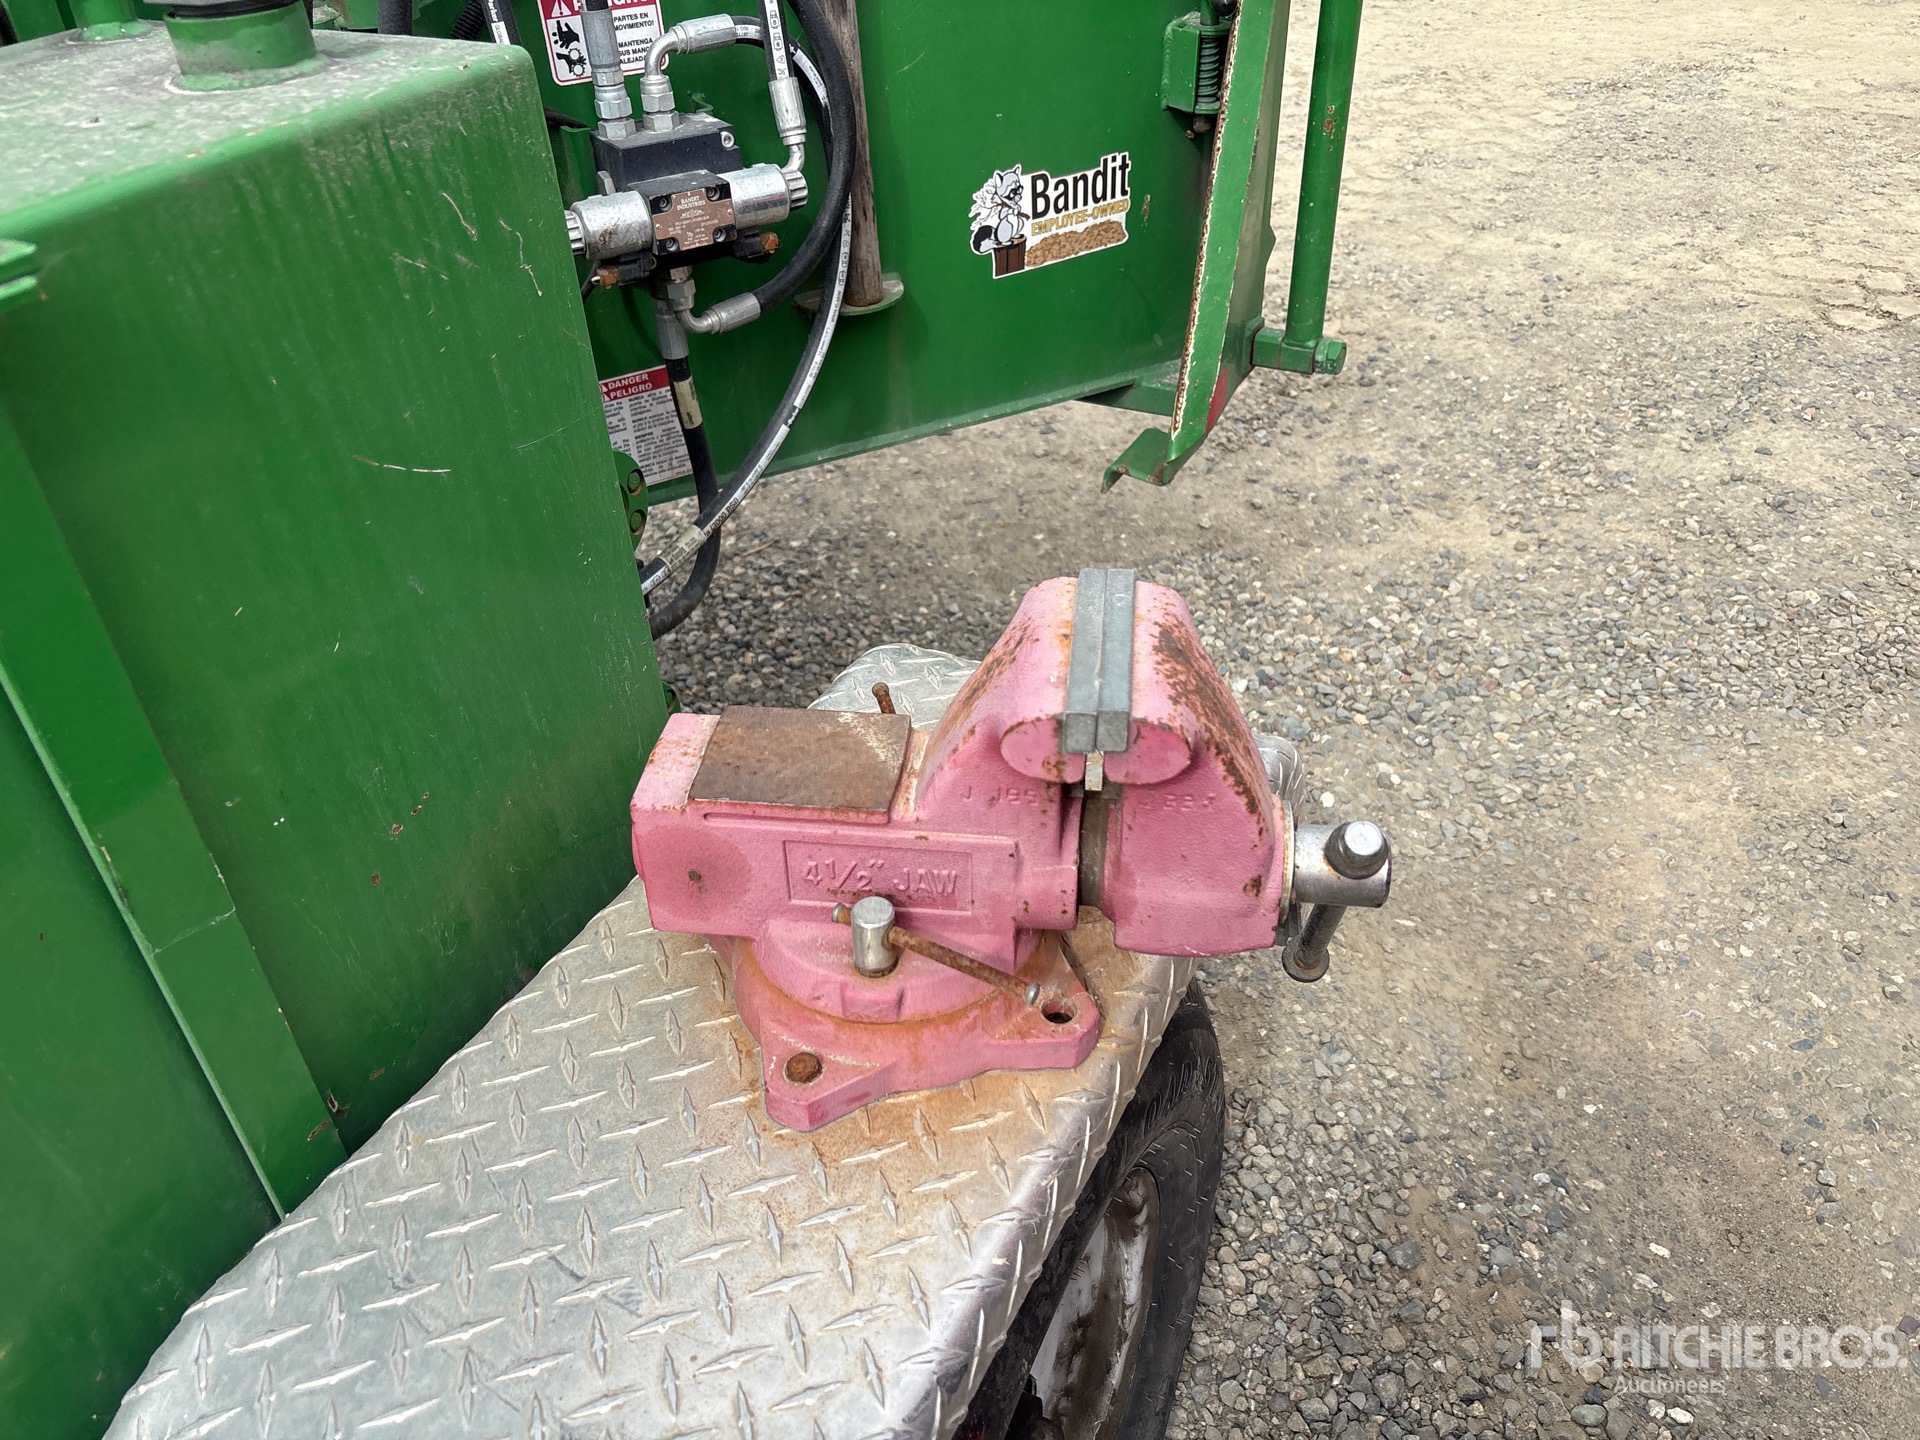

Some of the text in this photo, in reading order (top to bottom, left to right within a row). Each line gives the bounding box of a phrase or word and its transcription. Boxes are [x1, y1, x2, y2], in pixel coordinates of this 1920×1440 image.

[613, 12, 649, 23] PARTES EN
[618, 38, 654, 48] MANTENGA
[1031, 153, 1129, 220] Bandit
[1031, 199, 1129, 236] EMPLOYEE-OWNED
[608, 373, 649, 390] DANGER
[610, 382, 653, 399] PELIGRO
[893, 867, 958, 894] JAW
